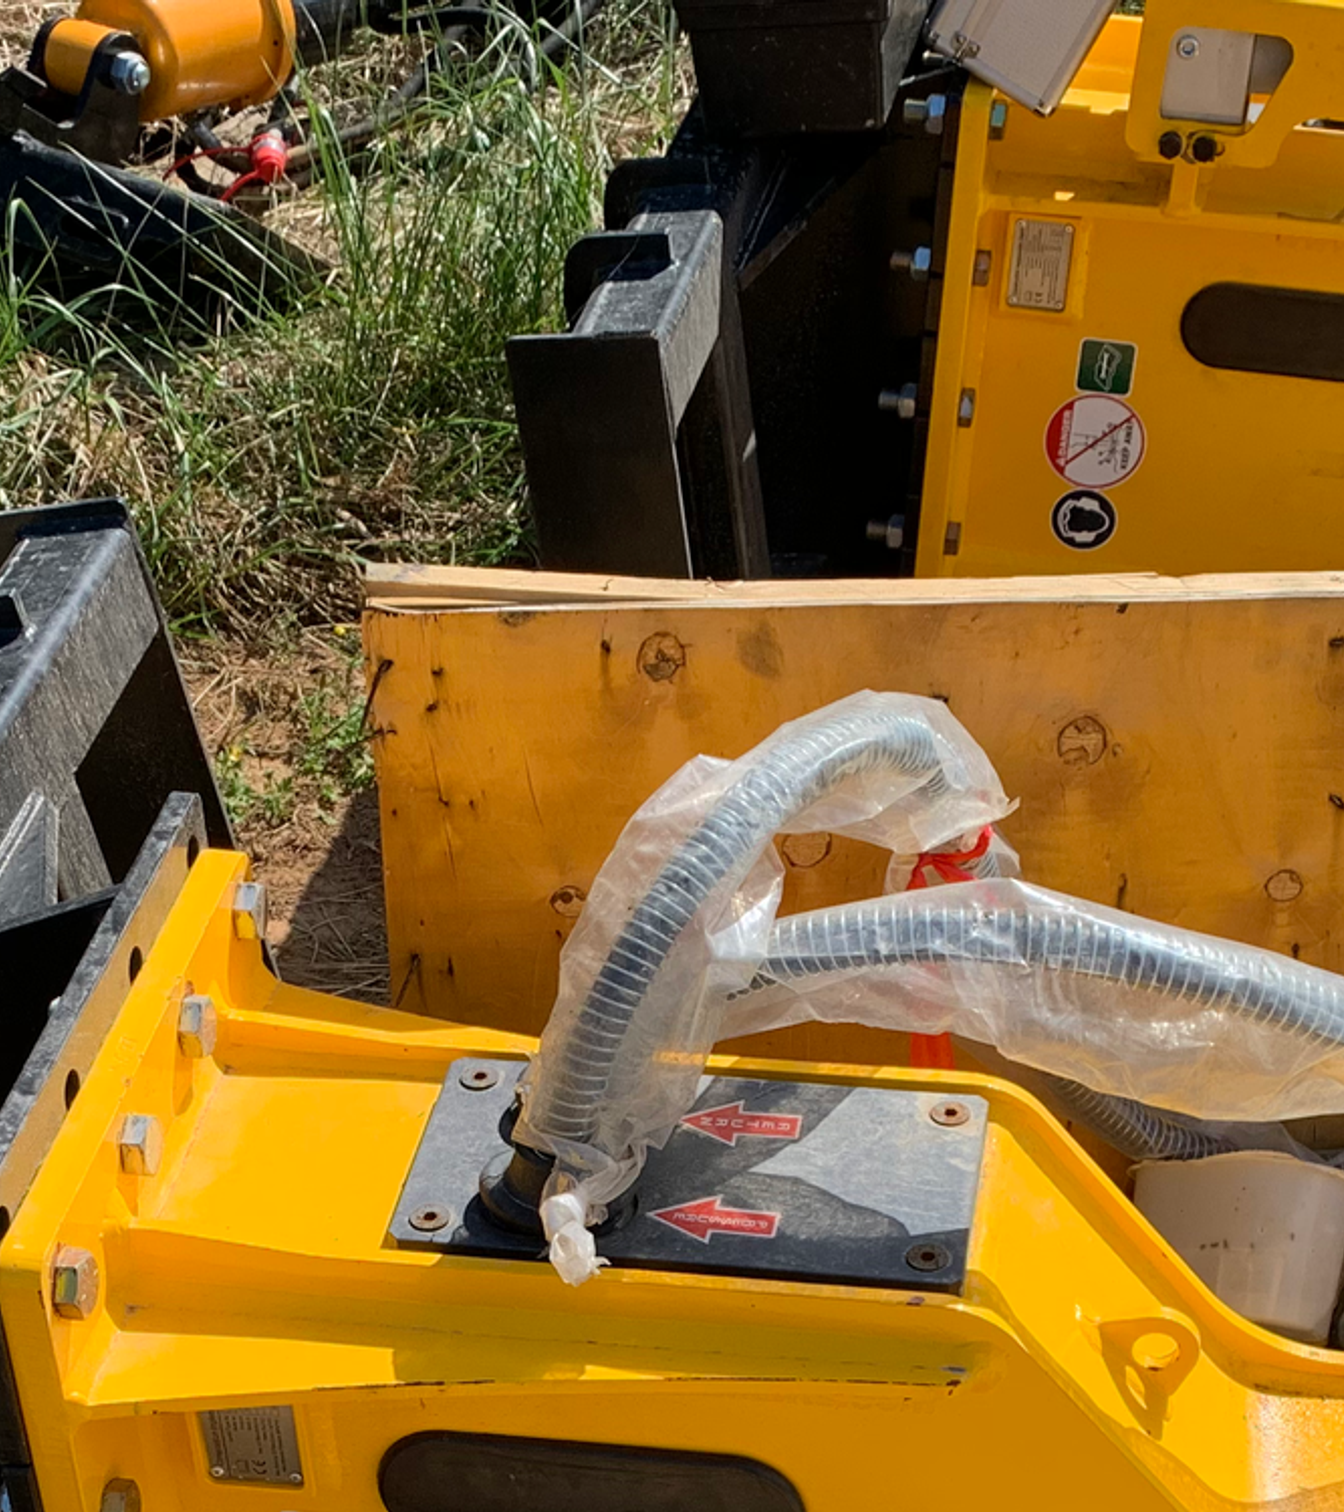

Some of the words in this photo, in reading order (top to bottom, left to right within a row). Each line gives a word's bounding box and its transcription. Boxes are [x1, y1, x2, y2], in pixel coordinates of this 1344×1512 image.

[1057, 409, 1072, 456] DANGER
[1120, 446, 1129, 470] KEEP
[699, 1116, 791, 1131] RETURN
